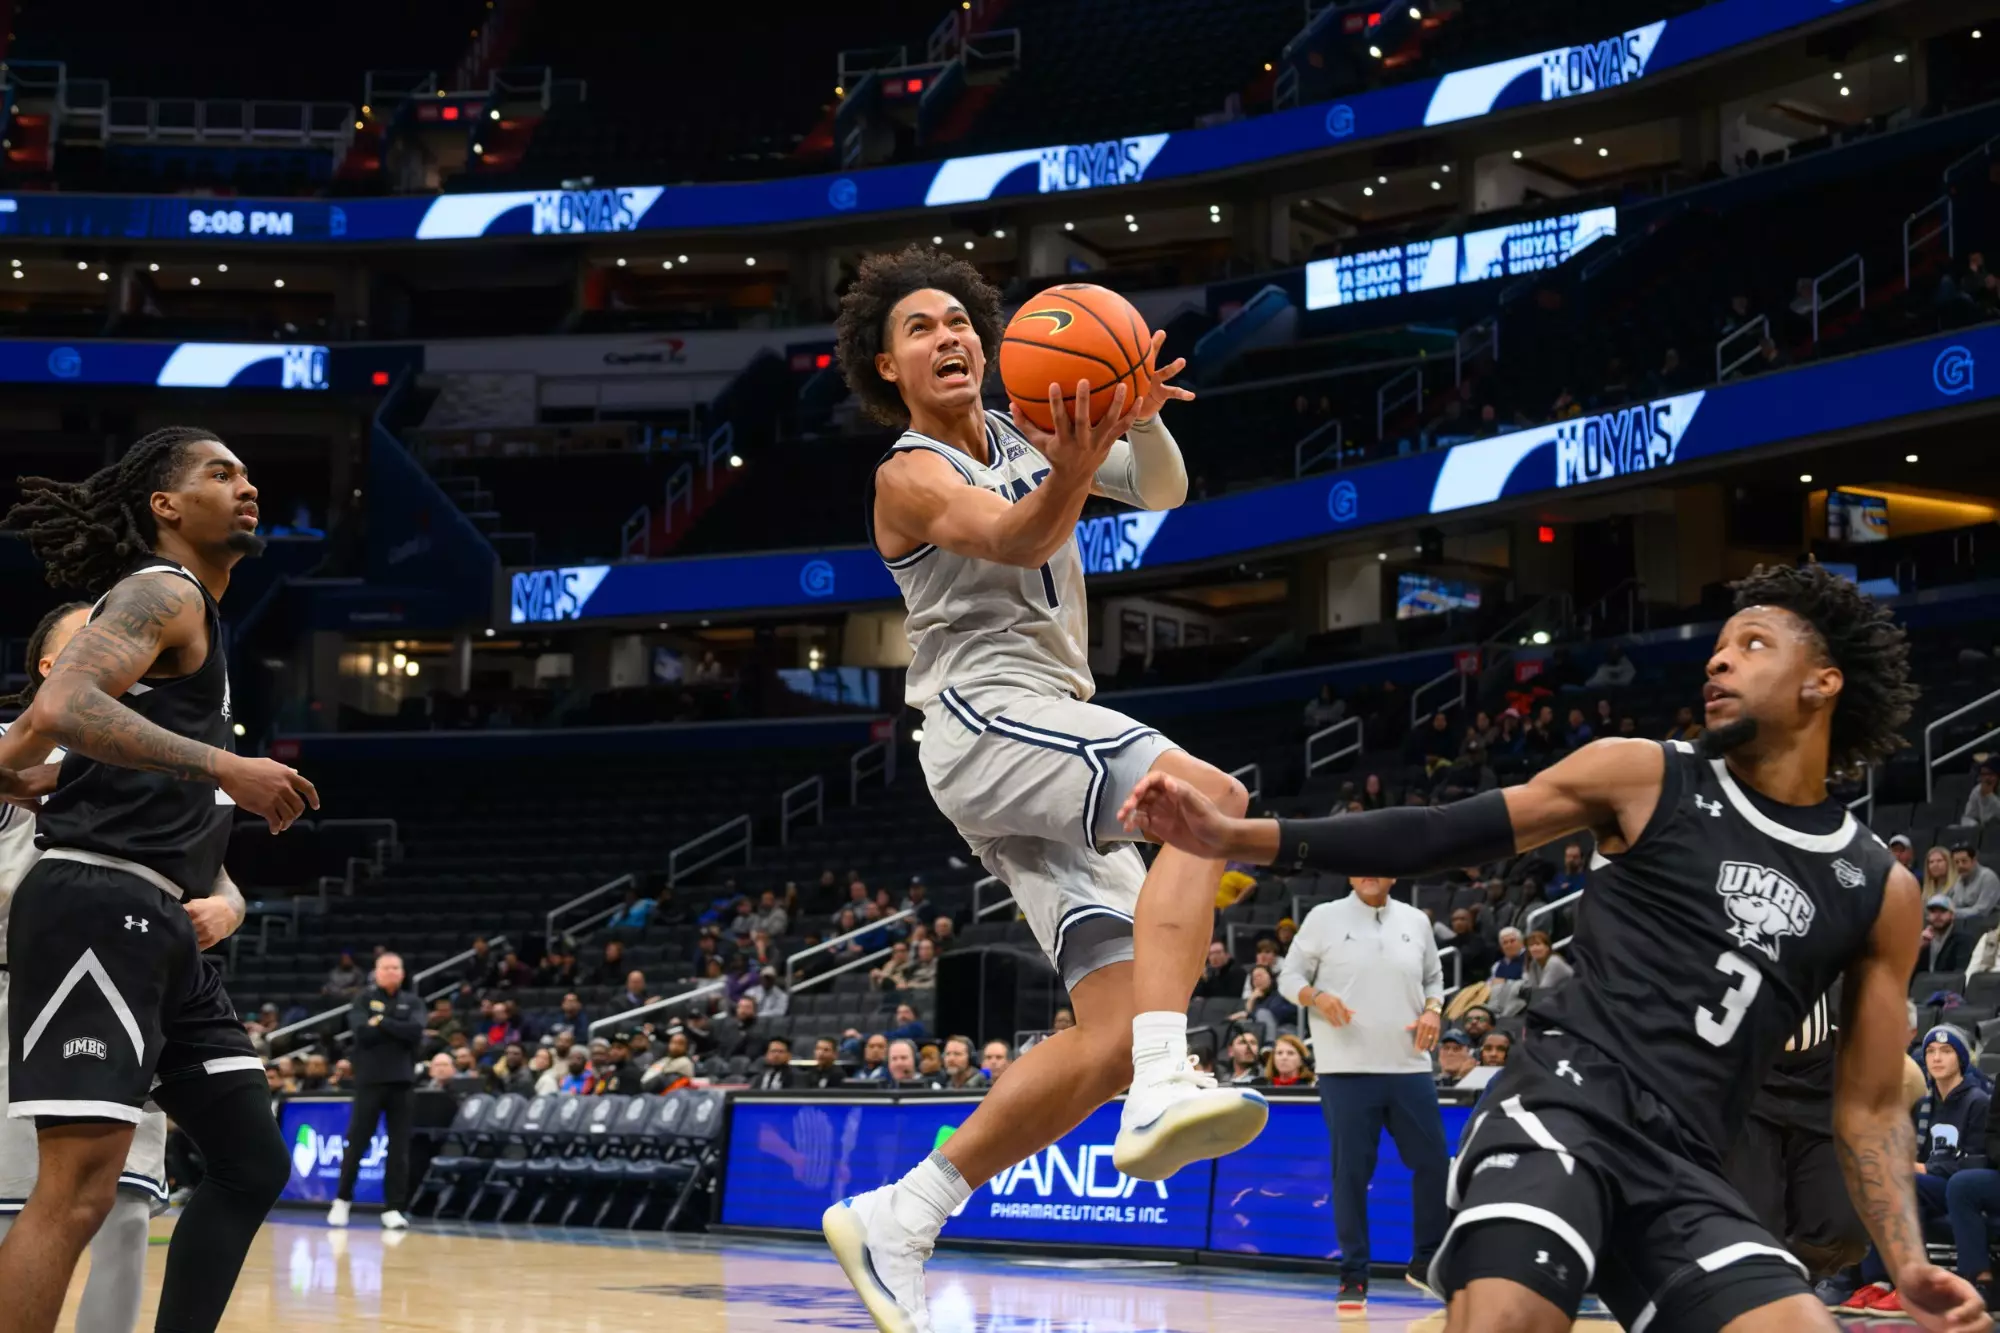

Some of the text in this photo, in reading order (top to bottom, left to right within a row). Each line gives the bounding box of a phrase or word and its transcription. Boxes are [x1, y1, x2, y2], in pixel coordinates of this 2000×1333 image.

[188, 209, 293, 235] 9:08 PM
[1556, 400, 1676, 488] HOYAS
[1718, 862, 1814, 936] UMBC
[1695, 950, 1763, 1047] 3
[63, 1037, 107, 1059] UMBC
[990, 1202, 1135, 1222] PHARMACEUTICALS
